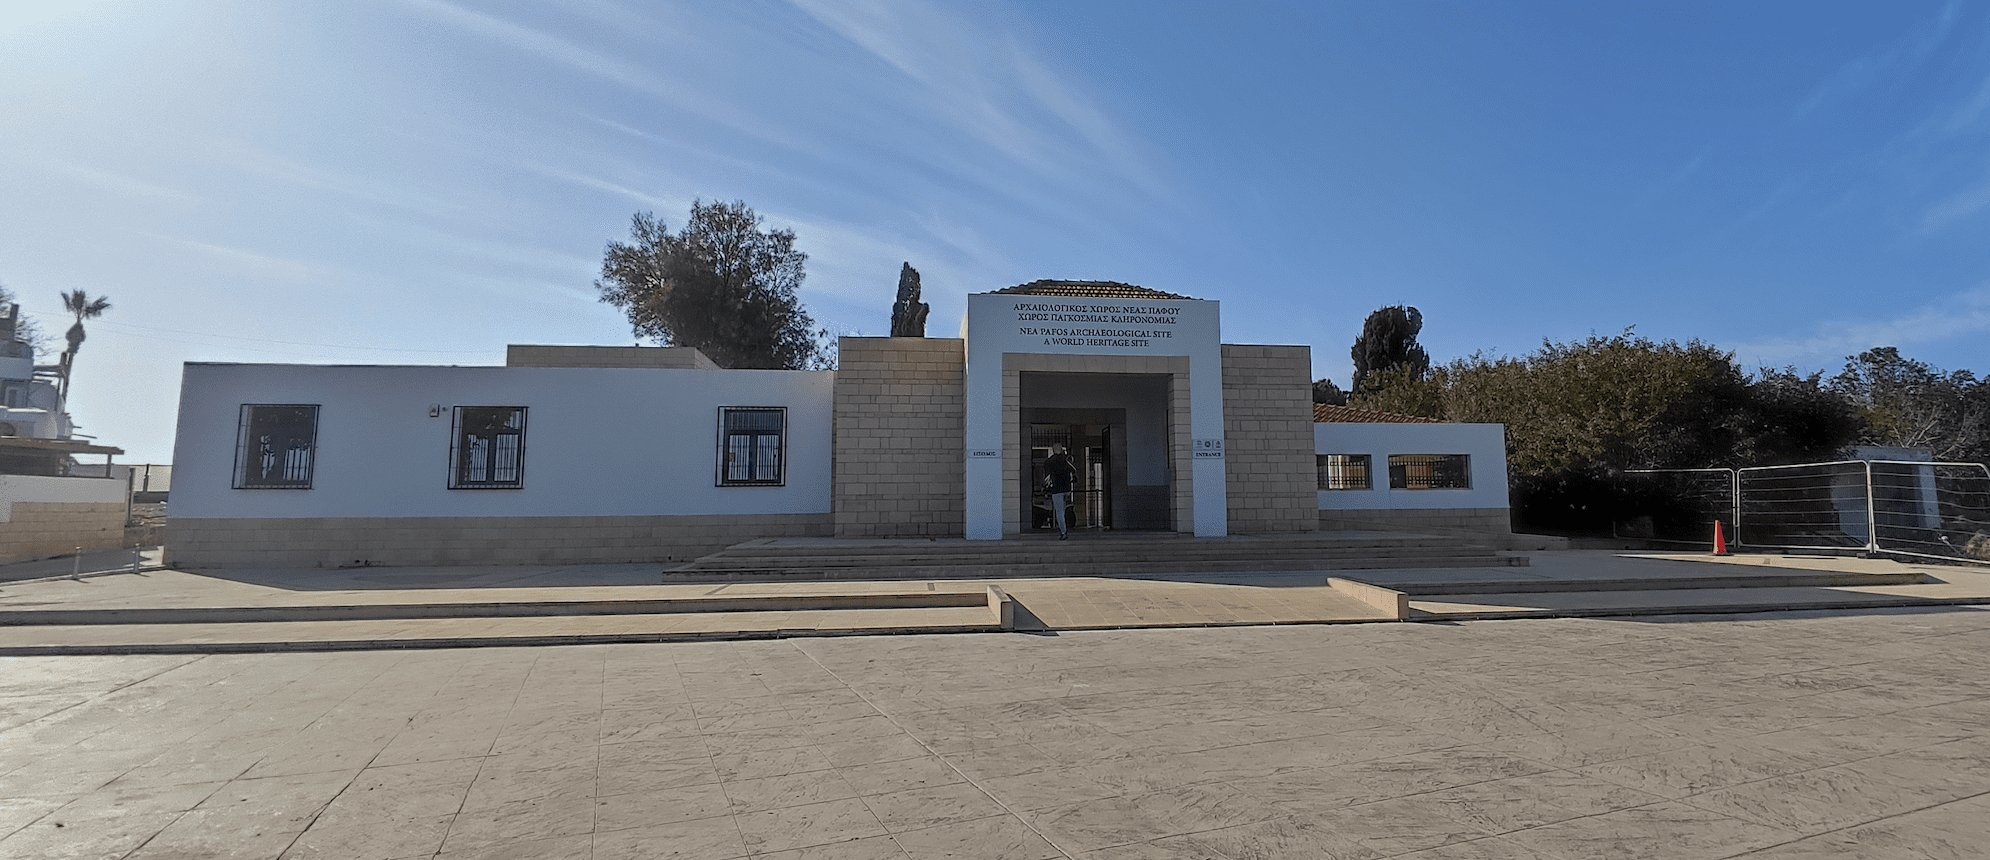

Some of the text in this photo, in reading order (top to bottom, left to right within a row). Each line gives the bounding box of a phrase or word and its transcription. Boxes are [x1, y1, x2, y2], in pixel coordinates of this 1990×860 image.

[1013, 303, 1180, 315] ΑΡΧΑΙΟΛΟΓΙΚΟΣ ΧΩΡΟΣ ΝΕΑΣ ΠΑΦΟΥ
[1018, 313, 1177, 324] ΧΩΡΟΣ ΠΑΓΚΟΣΜΙΑΣ ΚΛΗΡΟΝΟΜΙΑΣ
[1019, 327, 1173, 338] NEA PAFOS ARCHAEOLOGICAL SITE
[1052, 337, 1085, 346] WORLD
[1086, 338, 1130, 347] HERITAGE
[1131, 339, 1150, 347] SITE
